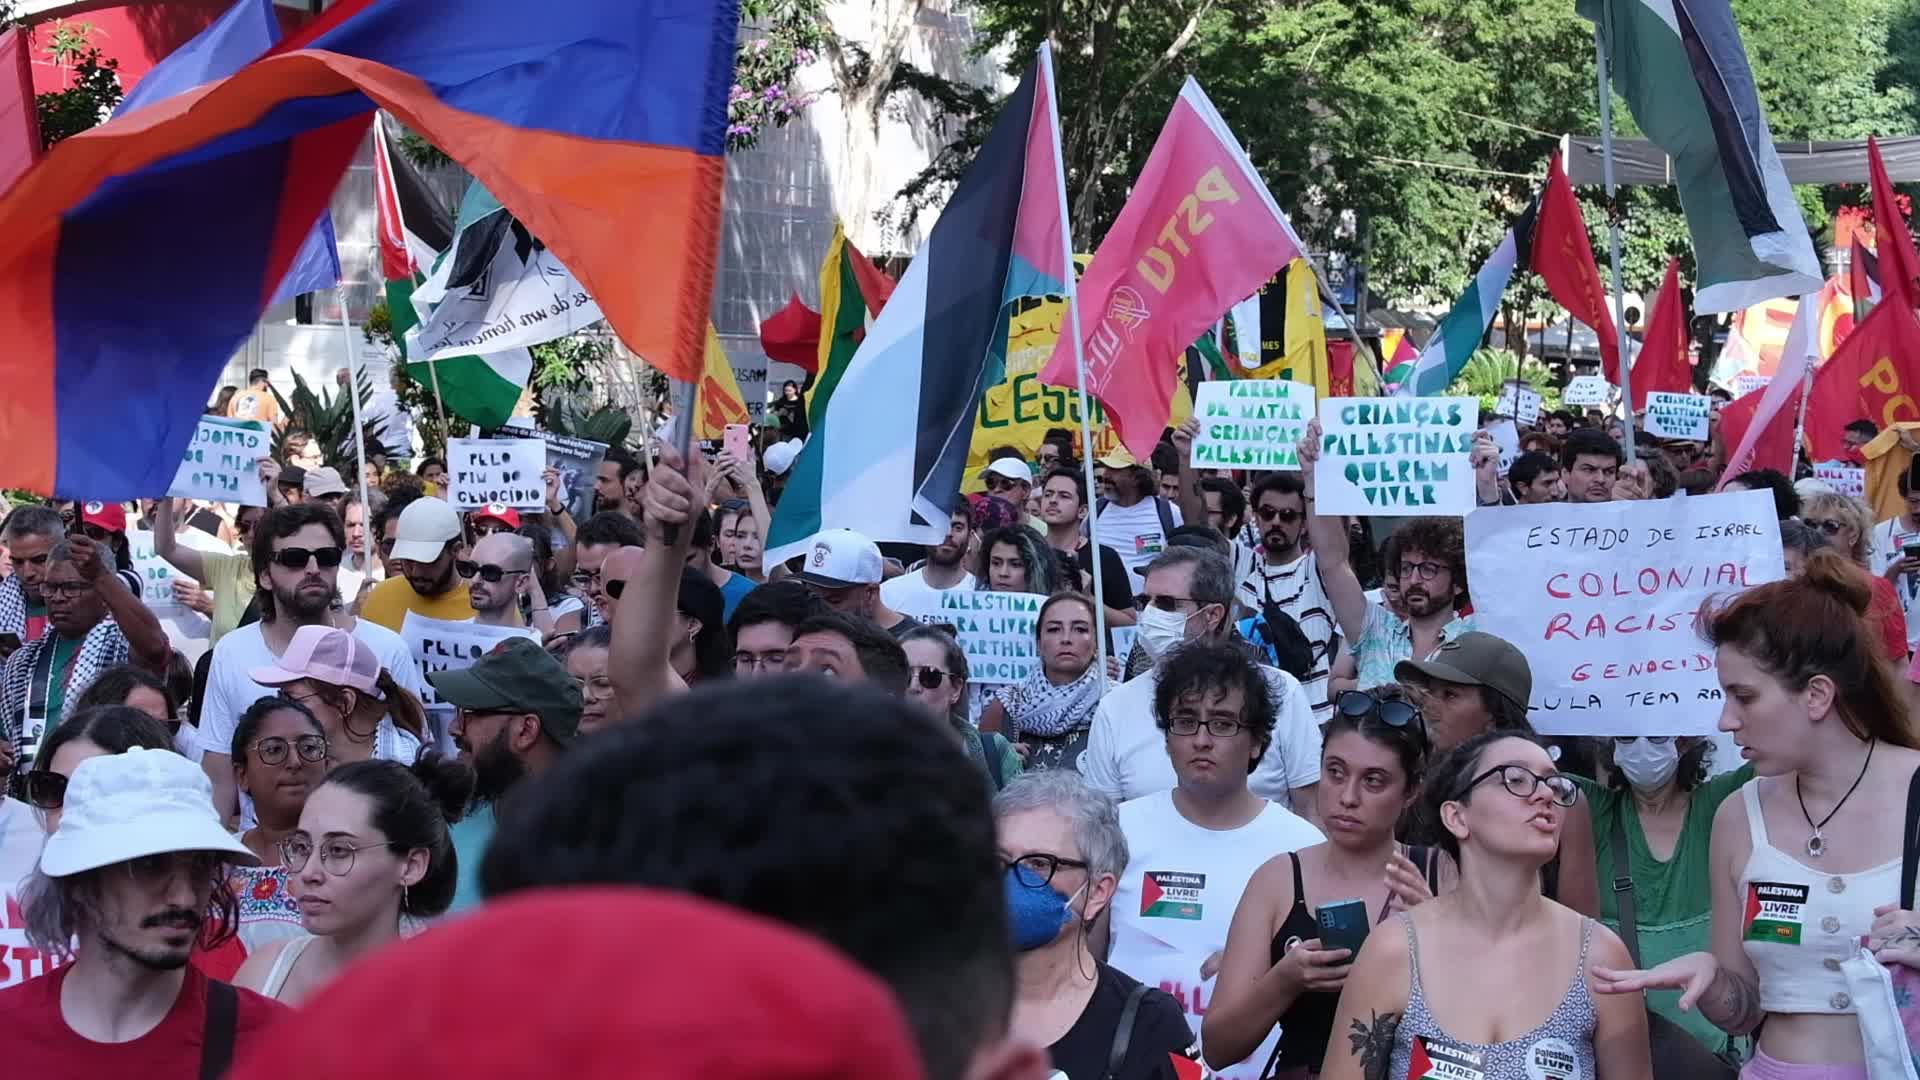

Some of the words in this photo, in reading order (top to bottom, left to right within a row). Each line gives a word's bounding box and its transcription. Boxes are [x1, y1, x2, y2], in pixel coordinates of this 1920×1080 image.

[1229, 382, 1289, 398] PAREM
[1241, 402, 1302, 420] MATAR
[1341, 402, 1463, 428] CRIANÇAS
[1210, 424, 1300, 444] CRIANÇAS
[1323, 432, 1474, 456] PALESTINAS
[470, 452, 511, 467] PELO
[458, 471, 487, 484] FIM
[502, 470, 521, 484] DO
[1344, 459, 1449, 486] QUEREM
[458, 486, 540, 503] GENOCÍDIO
[1362, 484, 1437, 506] VIVER
[1527, 526, 1629, 550] ESTADO
[1646, 528, 1676, 548] DE
[1695, 523, 1764, 540] ISRAEL
[941, 591, 1038, 612] PALESTINA
[423, 638, 482, 659] PELO
[1626, 692, 1679, 707] TEM
[1156, 875, 1200, 884] PALESTINA
[1167, 888, 1199, 897] LIVRE!
[1757, 886, 1803, 897] PALESTINA
[1764, 902, 1799, 914] LIVRE!
[1425, 1042, 1481, 1065] PALESTINA
[1535, 1047, 1574, 1063] Palestina
[1436, 1061, 1476, 1080] LIVRE!
[1535, 1055, 1574, 1073] Livre
